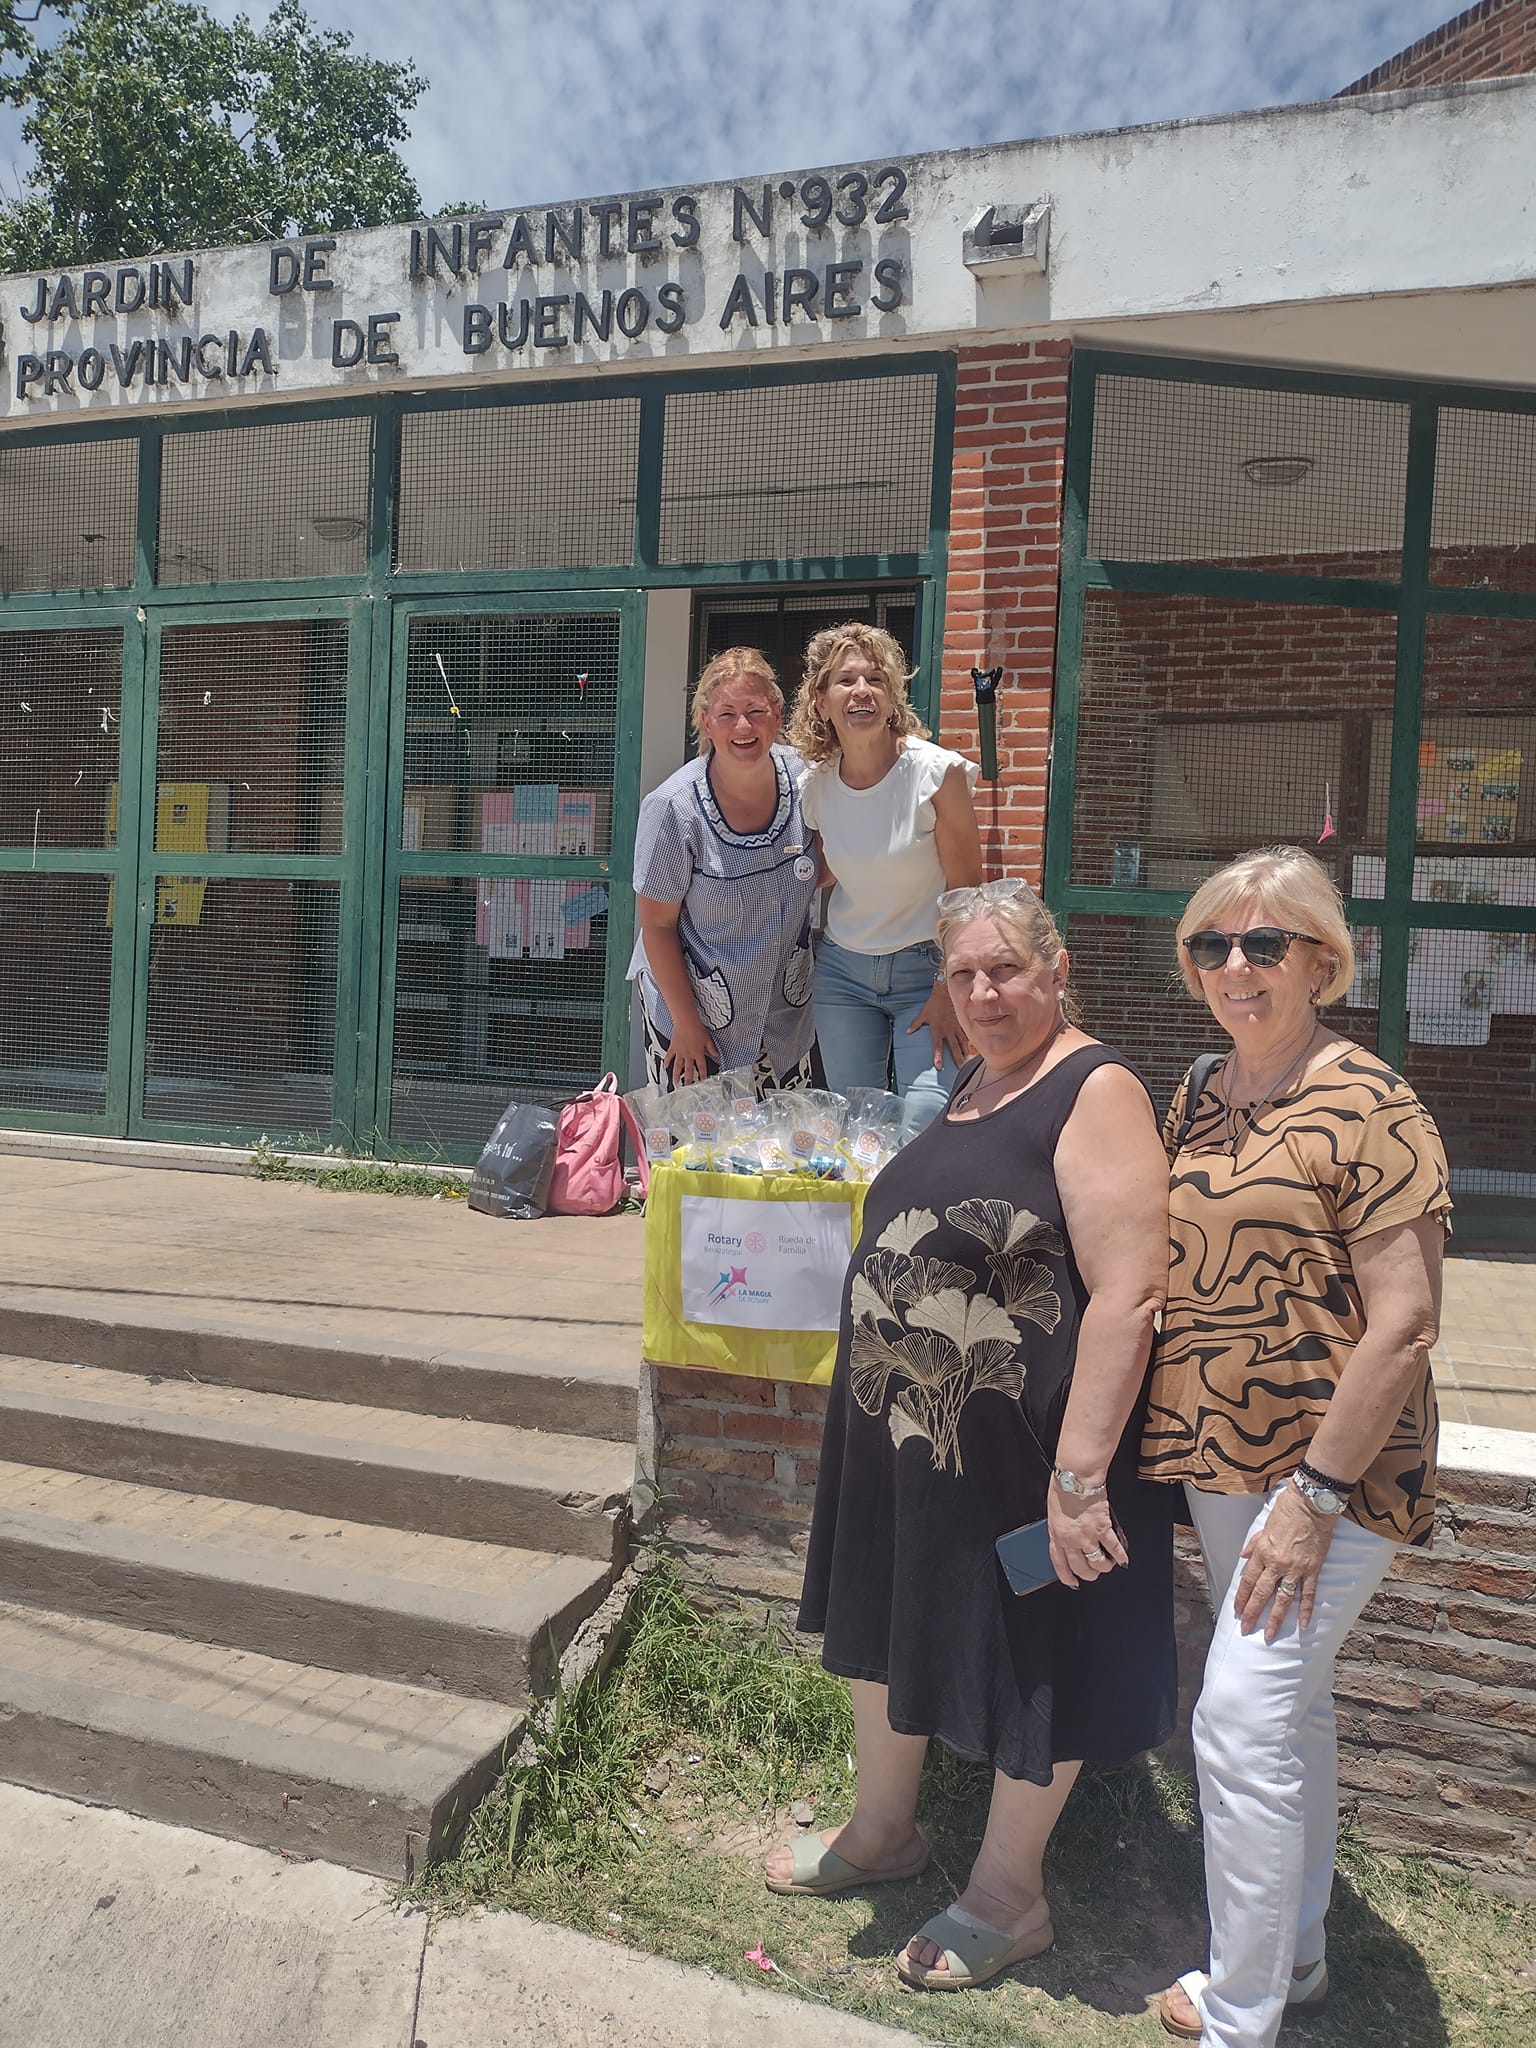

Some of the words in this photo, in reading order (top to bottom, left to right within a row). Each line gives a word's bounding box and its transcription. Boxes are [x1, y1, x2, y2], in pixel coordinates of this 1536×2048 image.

[20, 259, 194, 323] JARDIN
[269, 239, 336, 296] DE
[409, 196, 700, 279] INFANTES
[16, 327, 275, 399] PROVINCIA
[331, 312, 400, 368] DE
[463, 282, 686, 355] BUENOS
[719, 258, 905, 330] AIRES
[708, 1233, 742, 1248] Rotary
[778, 1235, 804, 1245] Rueda
[806, 1235, 817, 1245] de
[778, 1246, 807, 1255] Familia
[738, 1289, 748, 1297] LA
[749, 1290, 772, 1299] MAGIA
